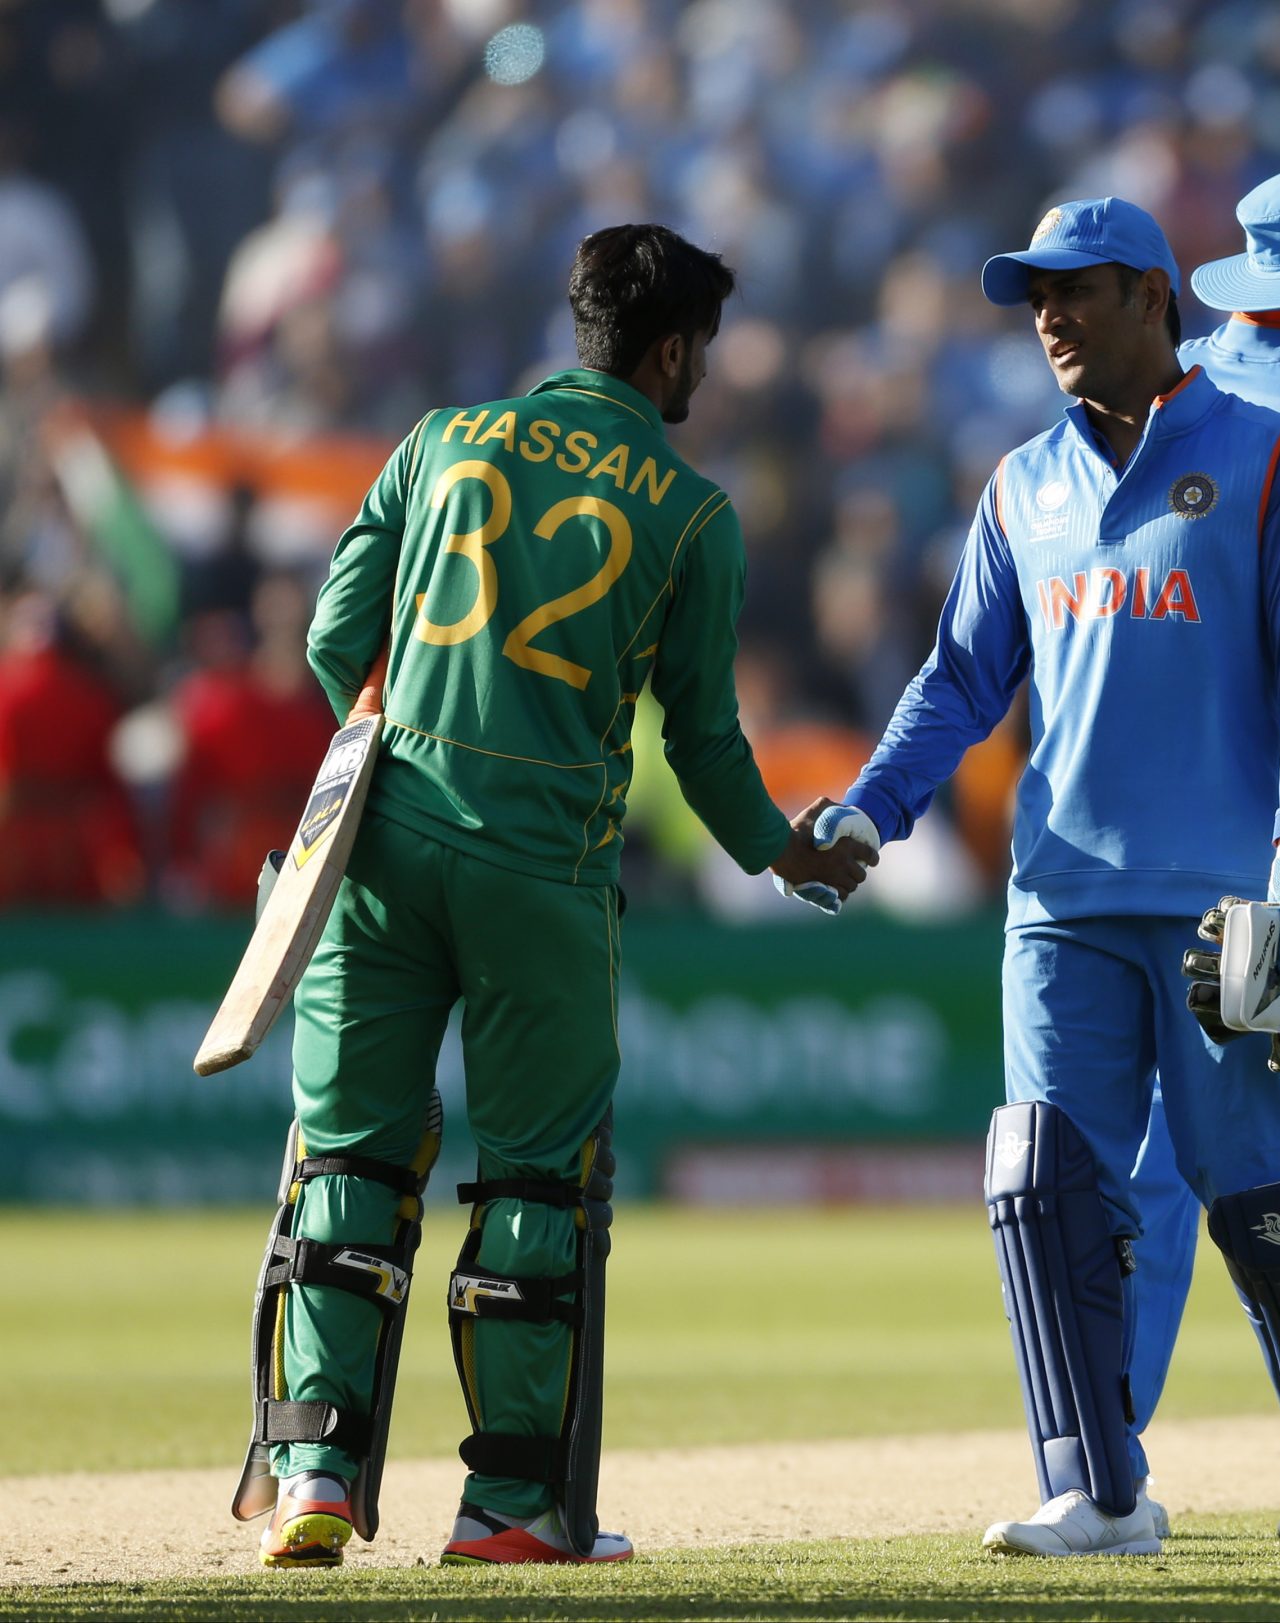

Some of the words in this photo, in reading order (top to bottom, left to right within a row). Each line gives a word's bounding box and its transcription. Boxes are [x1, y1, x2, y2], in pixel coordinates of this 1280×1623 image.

[441, 410, 678, 505] HASSAN
[415, 459, 633, 691] 32
[1036, 567, 1202, 633] INDIA
